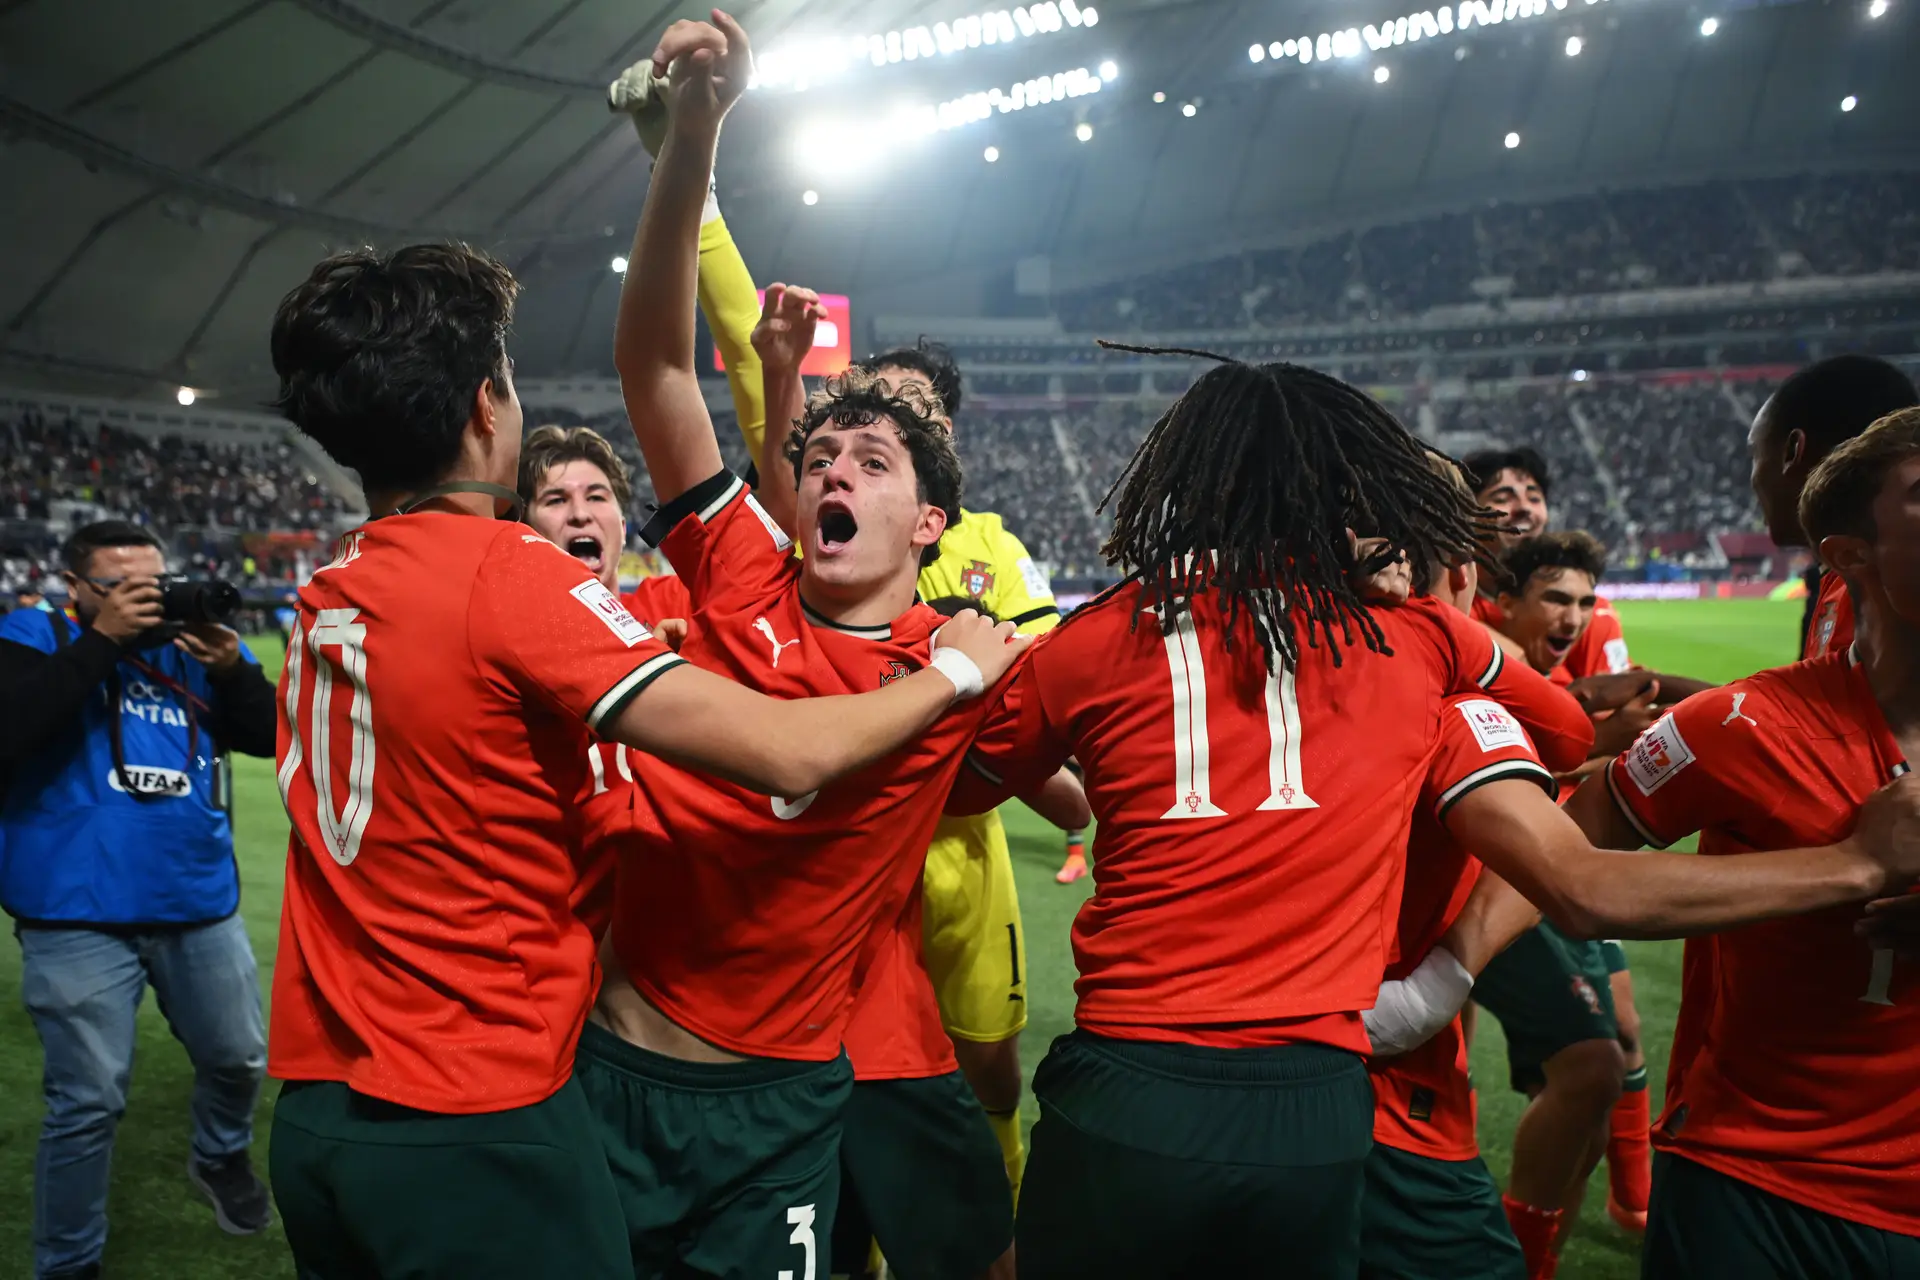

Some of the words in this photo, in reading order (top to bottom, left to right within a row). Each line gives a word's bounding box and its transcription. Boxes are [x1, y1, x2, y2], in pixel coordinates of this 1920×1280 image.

[1141, 588, 1321, 819] 11
[1644, 731, 1672, 767] U17
[1648, 761, 1660, 774] CUP
[1659, 735, 1669, 751] FIFA
[1005, 923, 1021, 987] 1
[778, 1203, 816, 1280] 3
